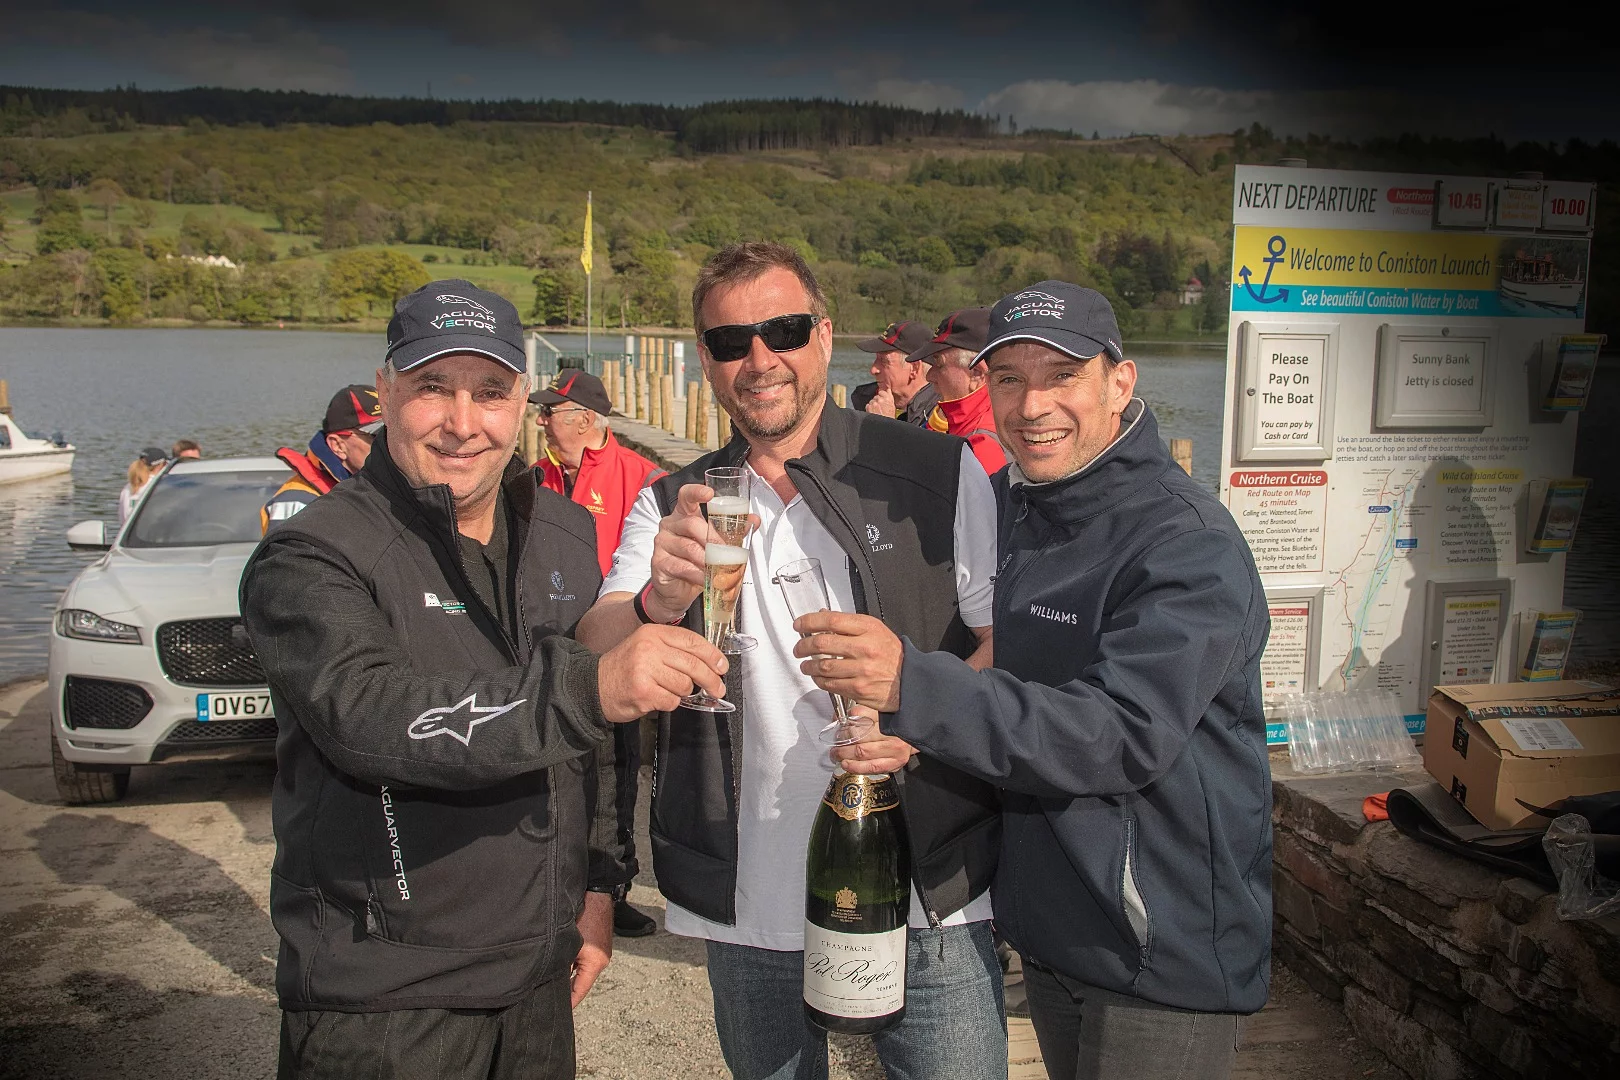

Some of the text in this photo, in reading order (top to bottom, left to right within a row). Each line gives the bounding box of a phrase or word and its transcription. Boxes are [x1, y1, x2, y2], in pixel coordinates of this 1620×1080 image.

[1239, 182, 1379, 213] NEXT DEPARTURE
[1447, 192, 1482, 210] 10.45
[1550, 198, 1586, 216] 10.00
[1290, 247, 1491, 276] Welcome to Coniston Launch
[1300, 289, 1480, 313] See beautiful Coniston Water by Boat
[1004, 302, 1066, 317] JAGUAR
[1004, 309, 1064, 323] VECTOR
[433, 311, 497, 324] JAGUAR
[430, 319, 497, 335] VECTOR
[1272, 353, 1309, 365] Please
[1412, 353, 1471, 367] Sunny Bank
[1269, 373, 1310, 387] Pay On
[1405, 375, 1474, 388] Jetty is closed
[1262, 392, 1314, 404] The Boat
[1261, 420, 1274, 428] You
[1290, 421, 1303, 430] pay
[1304, 420, 1314, 430] by
[1264, 432, 1281, 440] Cash
[1292, 432, 1308, 440] Card
[1346, 445, 1357, 453] the
[1383, 445, 1396, 454] hop
[1454, 445, 1488, 454] throughout
[1336, 454, 1355, 463] jetties
[1356, 454, 1368, 462] and
[1369, 454, 1386, 462] catch
[1392, 454, 1407, 462] later
[1408, 454, 1426, 463] sailing
[1443, 455, 1459, 463] using
[1238, 472, 1322, 485] Northern Cruise
[1442, 471, 1519, 481] Wild Cat Island Cruise
[1247, 489, 1260, 497] Red
[1262, 489, 1282, 497] Route
[1294, 488, 1311, 499] Map
[1447, 486, 1470, 494] Yellow
[1498, 485, 1513, 494] Map
[1259, 498, 1298, 508] 45 minutes
[1242, 509, 1260, 517] Calling
[1298, 508, 1313, 516] Torver
[1291, 526, 1308, 534] Water
[1261, 554, 1276, 563] Holly
[1030, 603, 1078, 625] WILLIAMS
[214, 695, 271, 716] OV67
[380, 785, 410, 901] AGUARVECTOR
[821, 940, 872, 952] CHAMPAGNE
[806, 952, 898, 992] Pol Roger
